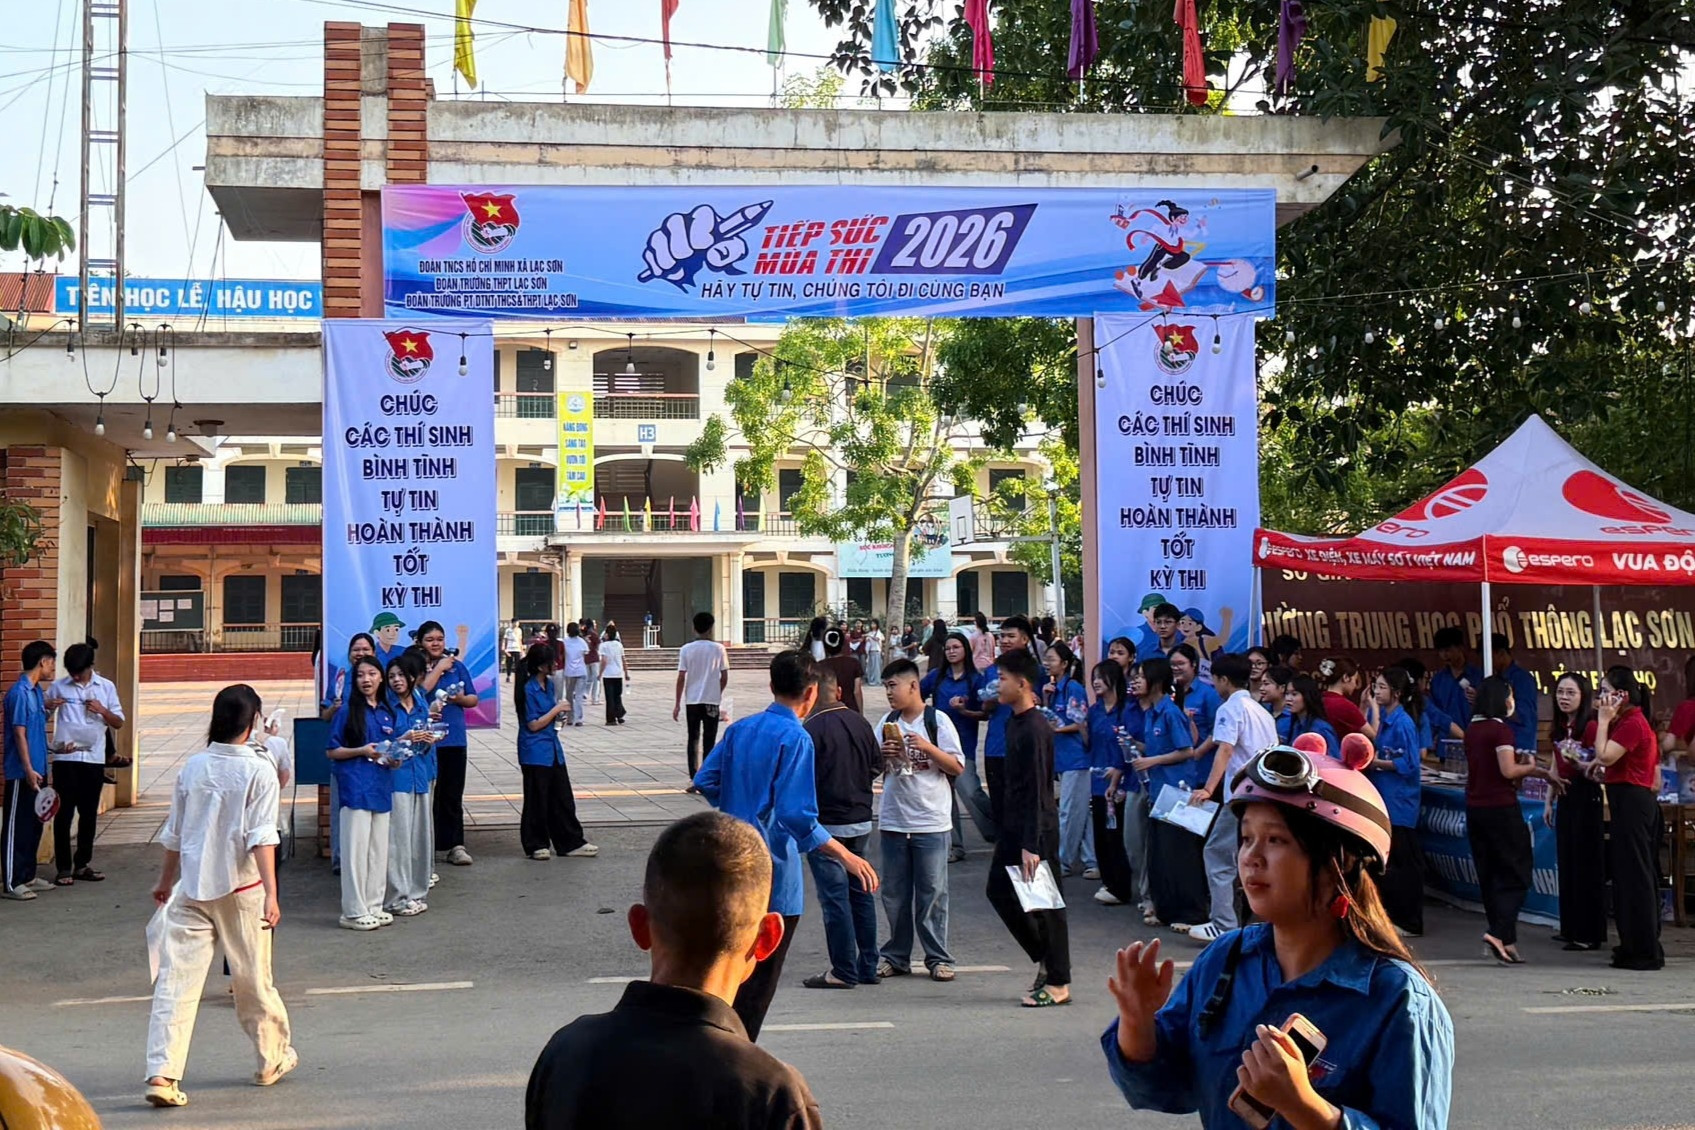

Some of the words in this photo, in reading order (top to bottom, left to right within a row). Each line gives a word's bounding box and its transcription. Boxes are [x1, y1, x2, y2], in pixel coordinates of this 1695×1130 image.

[761, 219, 826, 249] TIẾP
[830, 214, 889, 245] SỨC
[890, 211, 1014, 269] 2026
[419, 259, 441, 273] ĐOÀN
[443, 261, 464, 273] TNCS
[479, 258, 492, 273] CHÍ
[494, 261, 515, 273] MINH
[530, 261, 545, 275] LẠC
[547, 259, 563, 273] SƠN
[753, 249, 818, 274] MÙA
[825, 248, 874, 274] THI
[436, 276, 458, 290] ĐOÀN
[460, 275, 491, 290] TRƯỜNG
[493, 278, 512, 290] THPT
[514, 278, 529, 292] LẠC
[531, 276, 547, 290] SƠN
[701, 280, 736, 298] HÃY
[742, 281, 764, 301] TỰ
[769, 282, 797, 300] TIN,
[803, 279, 860, 298] CHÚNG
[867, 279, 893, 298] TÔI
[898, 282, 914, 297] ĐI
[918, 280, 964, 298] CÙNG
[970, 283, 1004, 301] BẠN
[66, 282, 117, 307] TÊN
[125, 287, 170, 311] HỌC
[217, 286, 261, 312] HẬU
[269, 290, 312, 313] HỌC
[380, 390, 438, 415] CHÚC
[1150, 380, 1203, 406] CHÚC
[345, 422, 390, 447] CÁC
[394, 421, 425, 447] THÍ
[429, 426, 473, 447] SINH
[640, 426, 655, 440] H3
[1118, 411, 1160, 436] CÁC
[1163, 411, 1190, 436] THÍ
[1194, 416, 1235, 436] SINH
[363, 454, 408, 479] BÌNH
[413, 454, 457, 478] TĨNH
[1134, 442, 1176, 467] BÌNH
[1181, 443, 1220, 466] TĨNH
[1151, 475, 1173, 502] TỰ
[1176, 477, 1204, 497] TIN
[381, 489, 406, 516] TỰ
[408, 490, 439, 510] TIN
[1120, 503, 1172, 528] HOÀN
[1176, 503, 1237, 528] THÀNH
[347, 518, 405, 543] HOÀN
[409, 517, 474, 542] THÀNH
[1161, 531, 1195, 559] TỐT
[393, 547, 429, 575] TỐT
[1304, 548, 1319, 561] XE
[1346, 552, 1362, 564] XE
[1362, 549, 1386, 565] MÁY
[1413, 551, 1443, 570] VIỆT
[1443, 551, 1476, 566] NAM
[1528, 554, 1594, 567] espero
[1612, 553, 1661, 570] VUA
[1150, 565, 1174, 589] KỲ
[1178, 570, 1206, 589] THI
[382, 582, 408, 608] KỲ
[412, 587, 442, 607] THI
[1335, 611, 1413, 649] TRUNG
[1518, 604, 1594, 649] THÔNG
[1599, 611, 1643, 656] LẠC
[1646, 607, 1695, 649] SƠN
